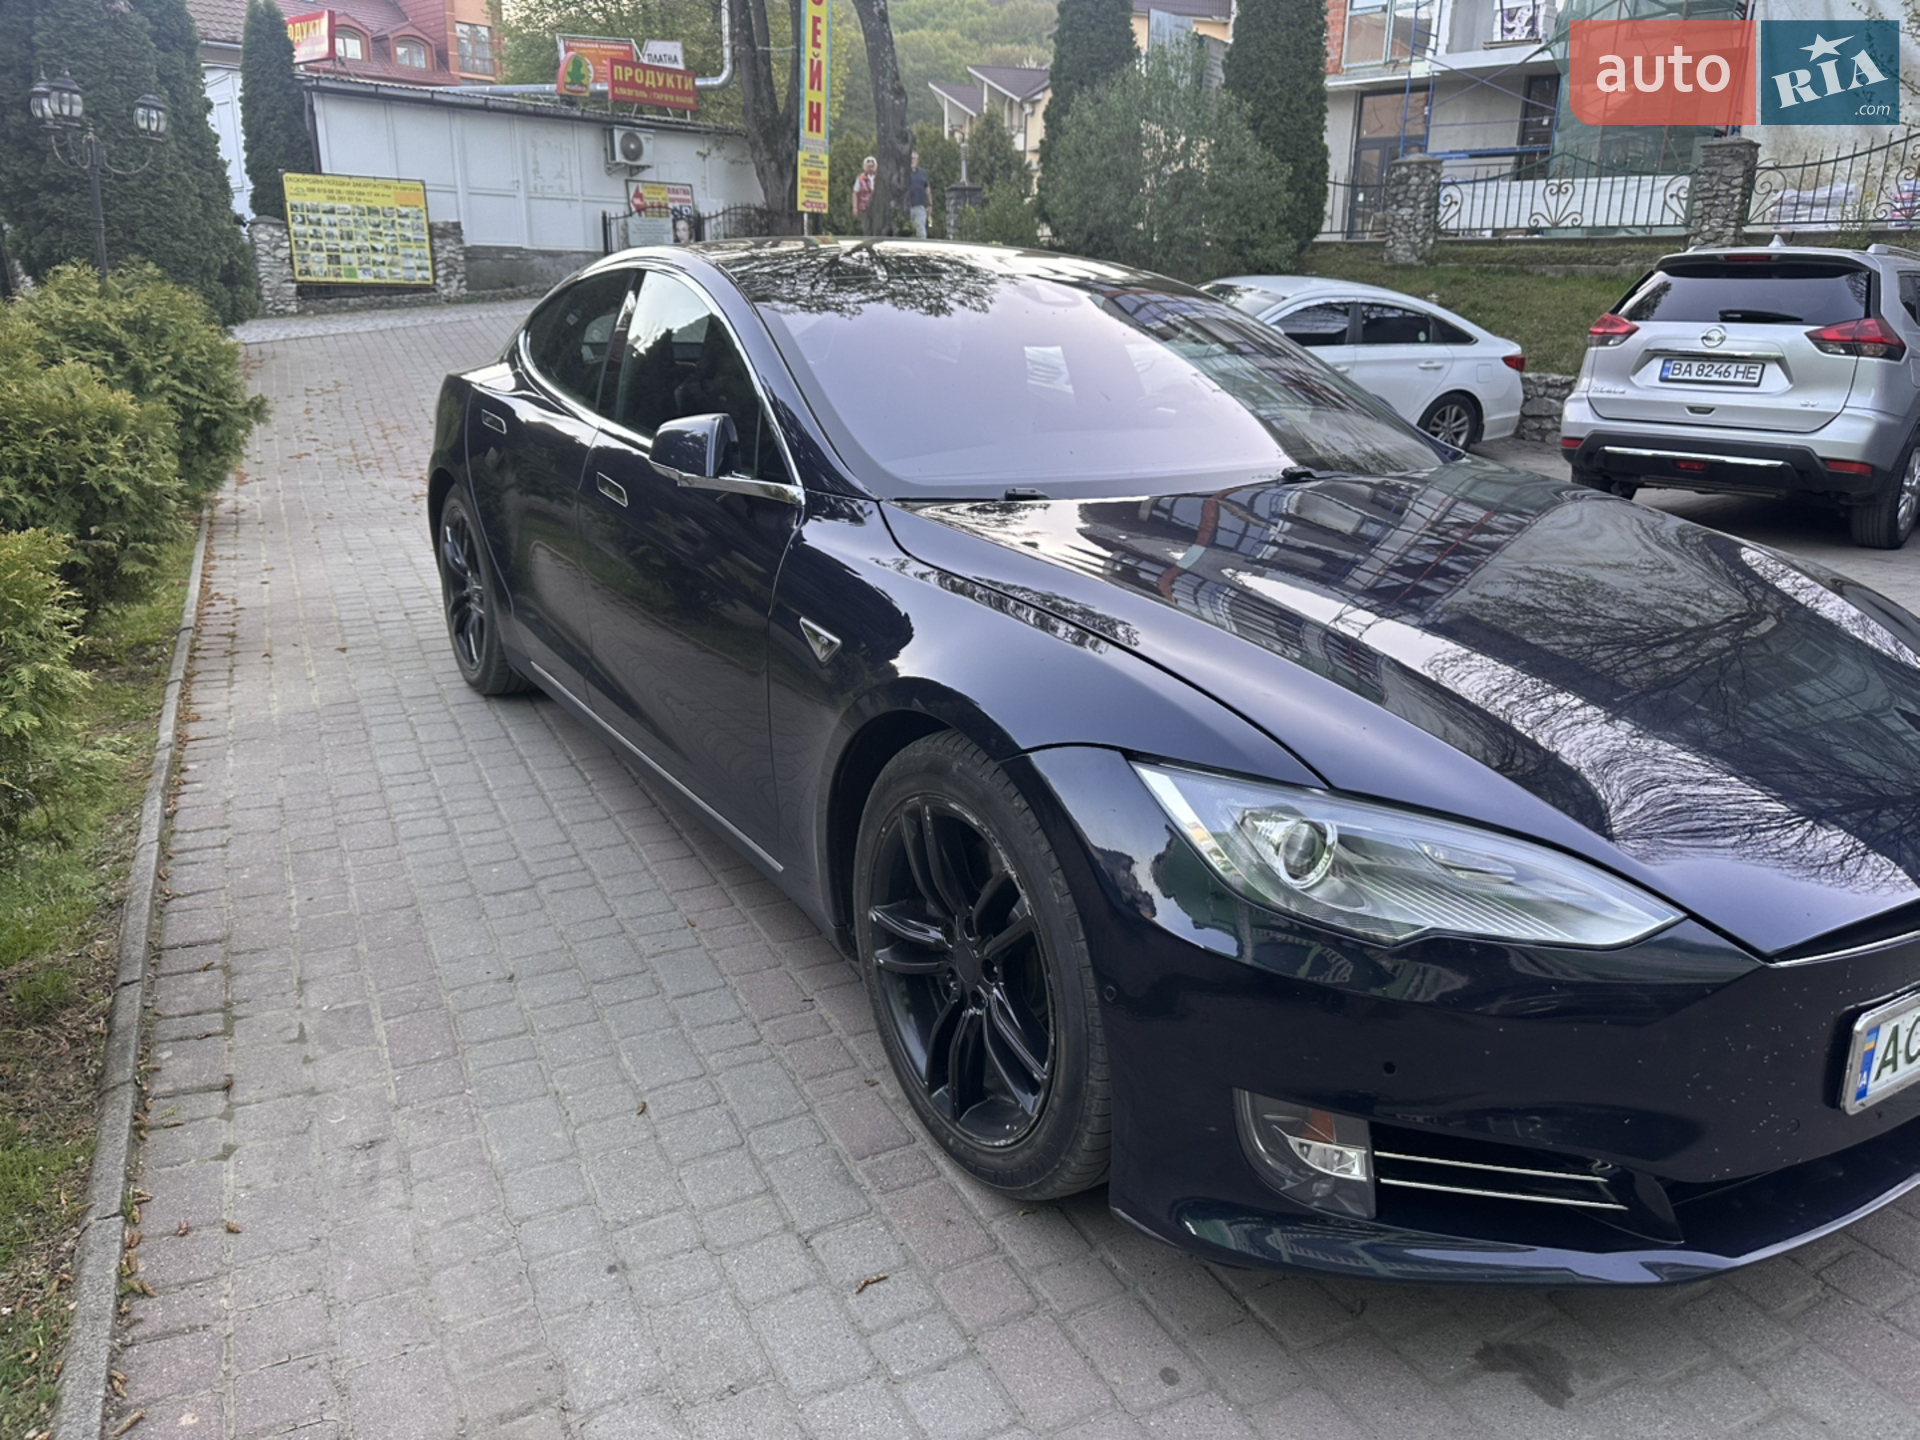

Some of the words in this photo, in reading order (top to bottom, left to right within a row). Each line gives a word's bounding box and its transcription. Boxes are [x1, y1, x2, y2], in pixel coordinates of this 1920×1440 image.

[646, 53, 680, 65] ПЛАТНА
[808, 0, 823, 135] ЕЙН
[613, 64, 694, 92] ПРОДУКТИ
[1671, 362, 1693, 377] BA
[1695, 363, 1732, 379] 8246
[1733, 365, 1760, 381] HE
